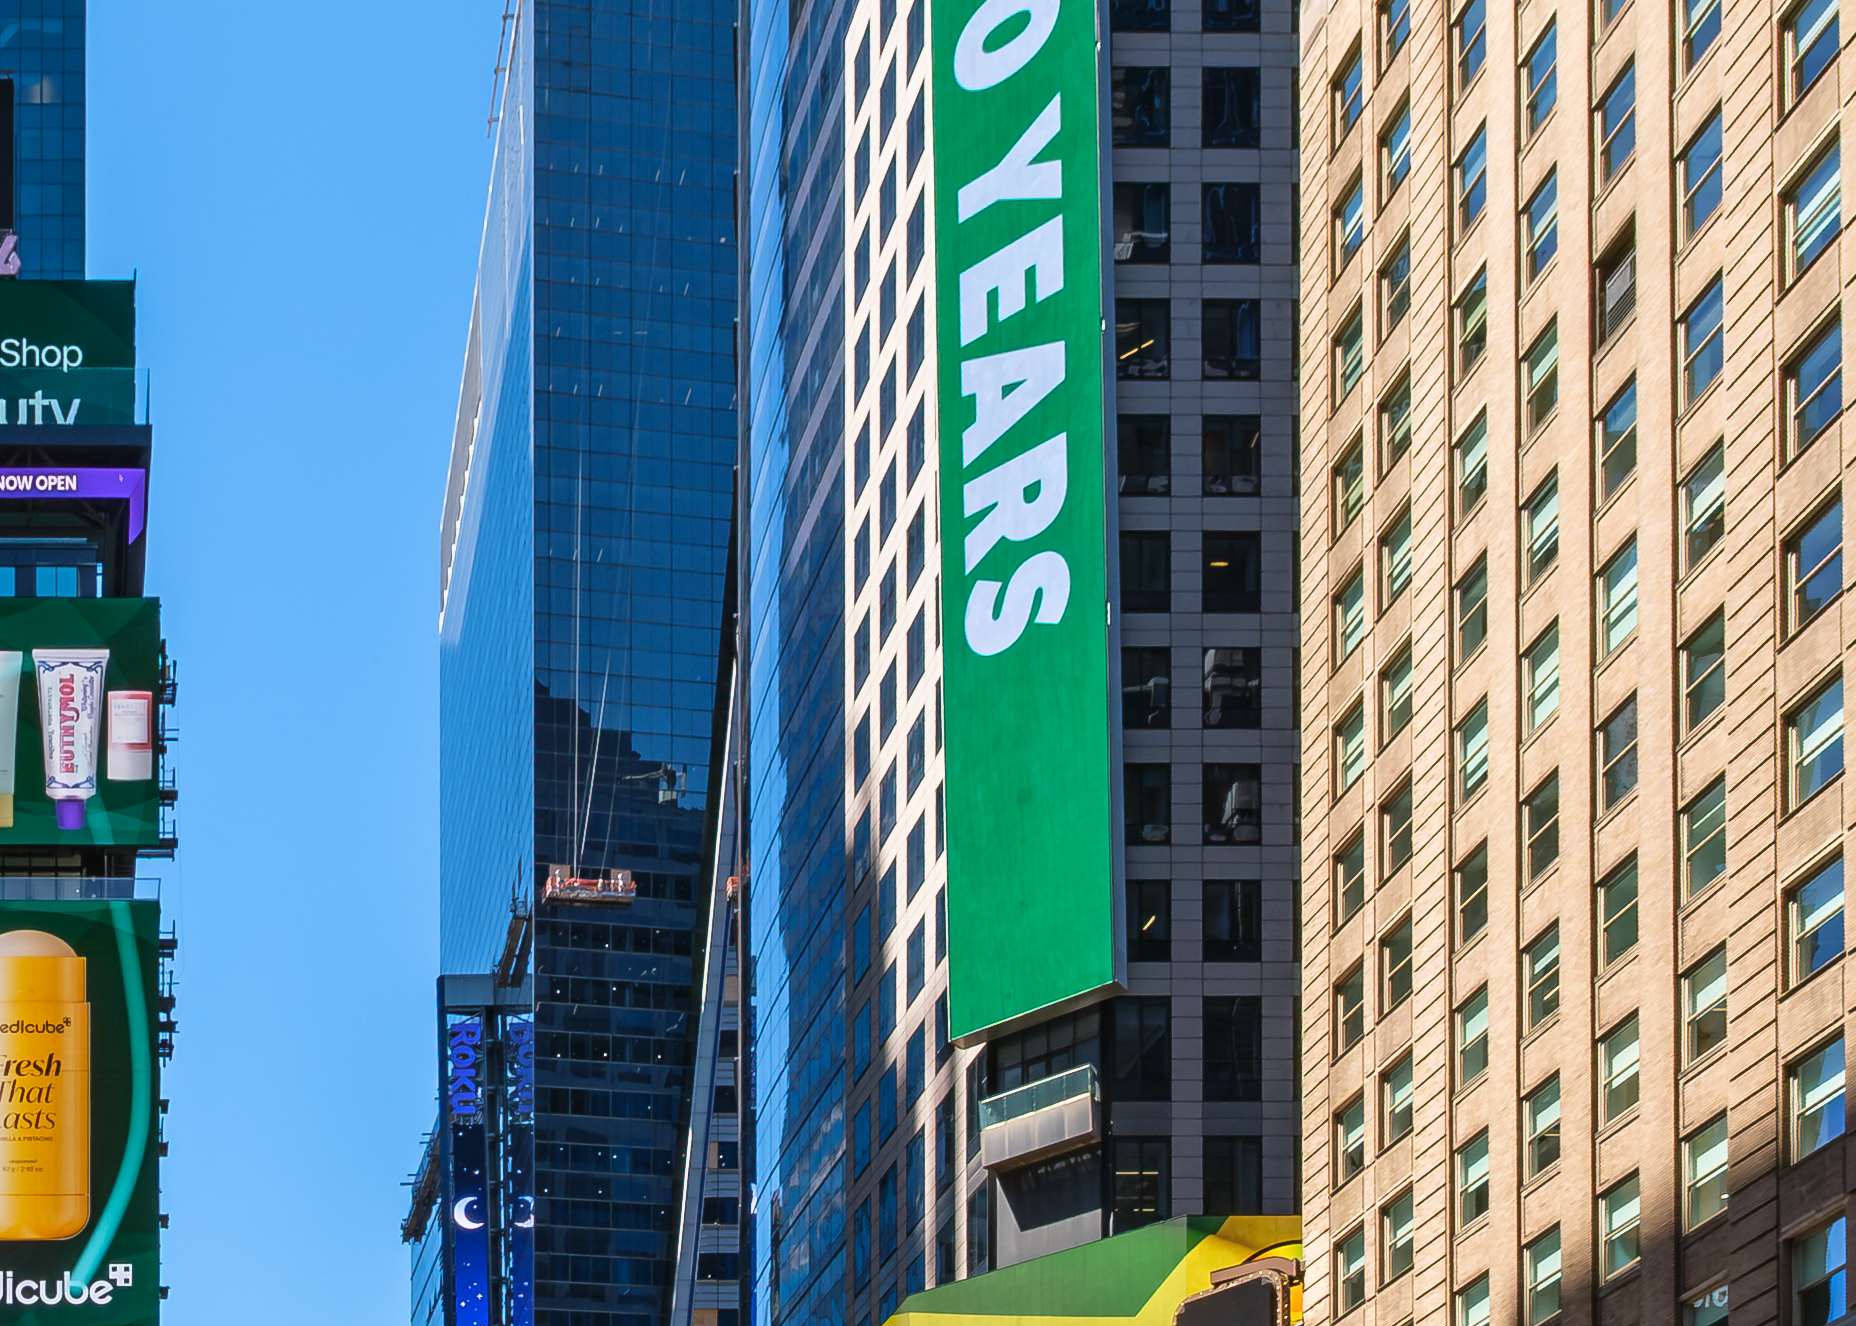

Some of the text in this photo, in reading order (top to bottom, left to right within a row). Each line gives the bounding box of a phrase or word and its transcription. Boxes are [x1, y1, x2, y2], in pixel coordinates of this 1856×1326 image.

[0, 338, 84, 373] Shop
[957, 93, 1072, 659] YEARS
[35, 475, 77, 492] OPEN
